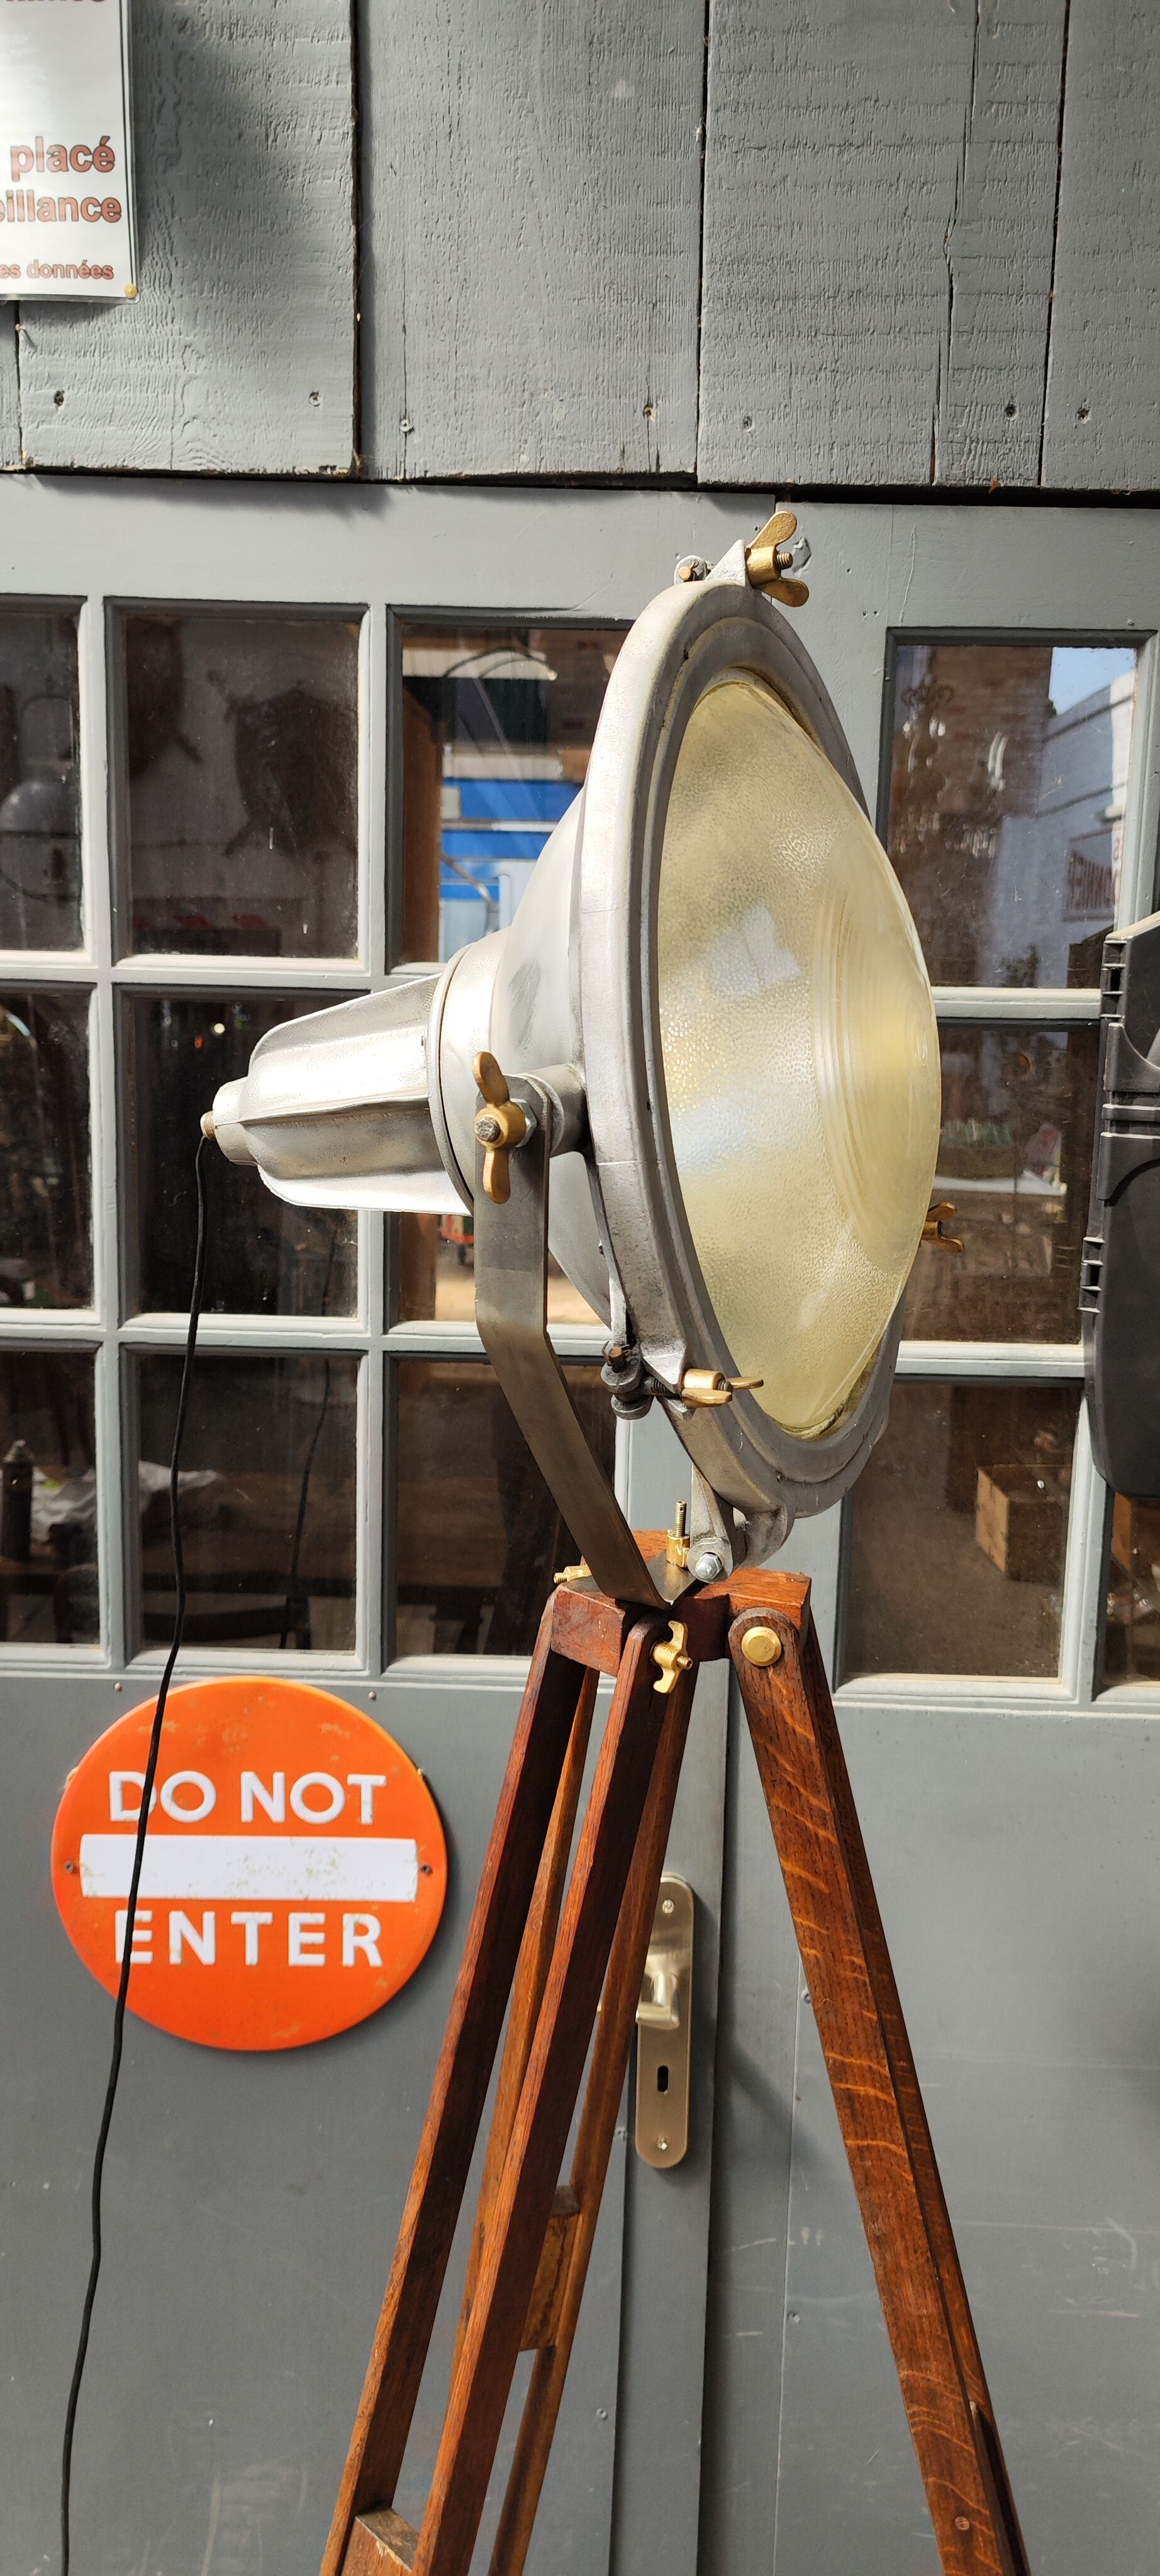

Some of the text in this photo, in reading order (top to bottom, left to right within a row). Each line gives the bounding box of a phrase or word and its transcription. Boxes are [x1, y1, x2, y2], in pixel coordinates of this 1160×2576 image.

[10, 136, 115, 181] placé
[0, 189, 121, 223] illance
[26, 259, 114, 280] données
[109, 1771, 386, 1824] DO NOT
[114, 1909, 383, 1967] ENTER
